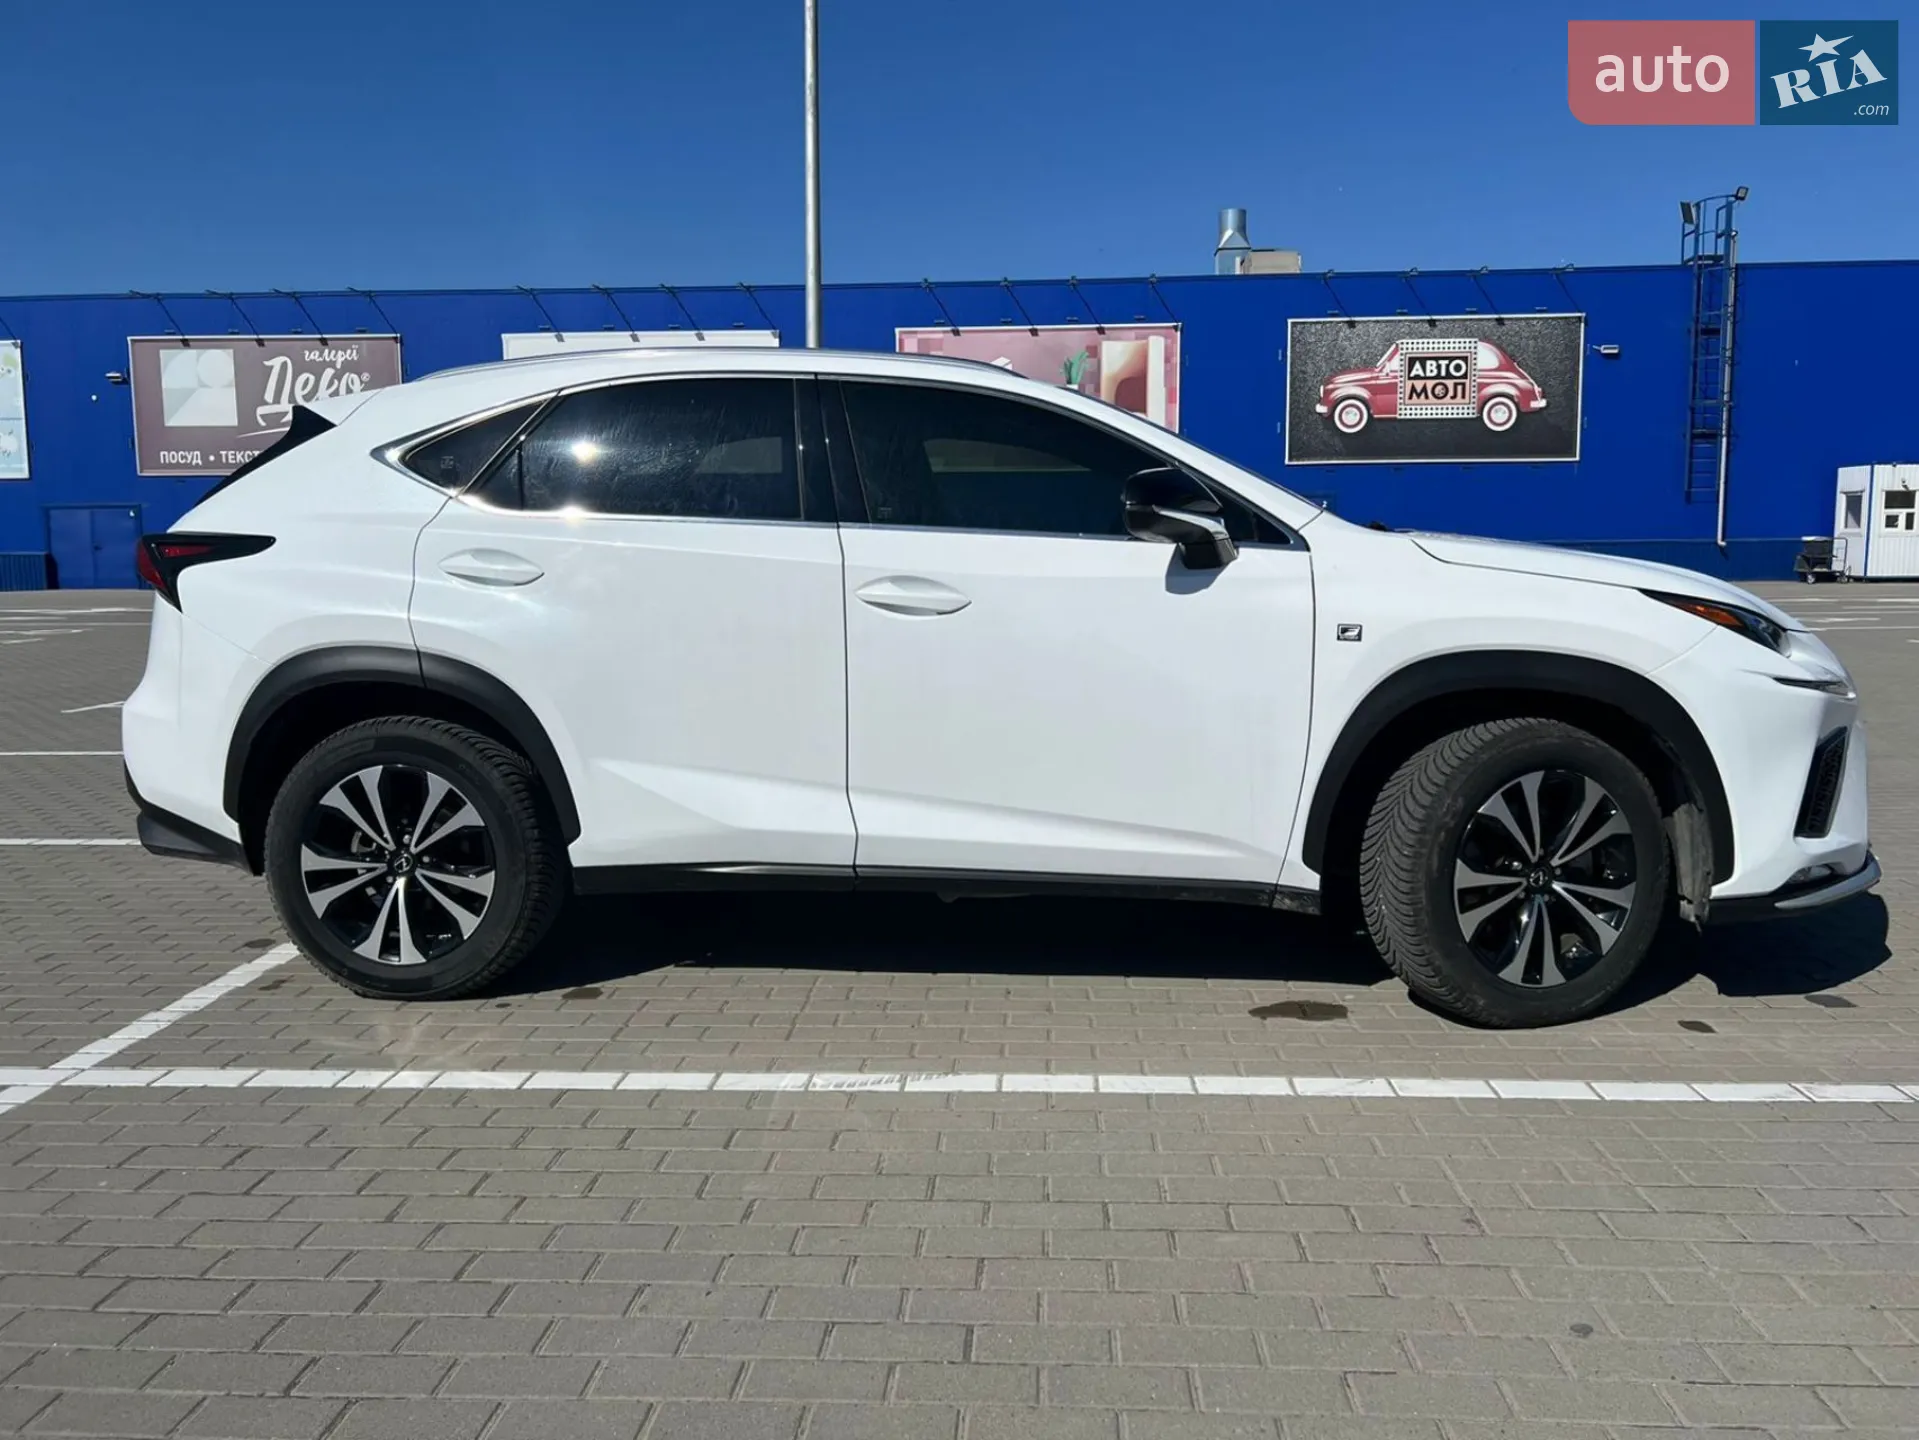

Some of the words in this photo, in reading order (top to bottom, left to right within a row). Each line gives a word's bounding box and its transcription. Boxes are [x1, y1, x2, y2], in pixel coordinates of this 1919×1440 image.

[303, 345, 360, 370] галереї
[1409, 359, 1467, 377] АВТО
[1408, 382, 1466, 400] МОЛ
[159, 450, 202, 466] ПОСУД
